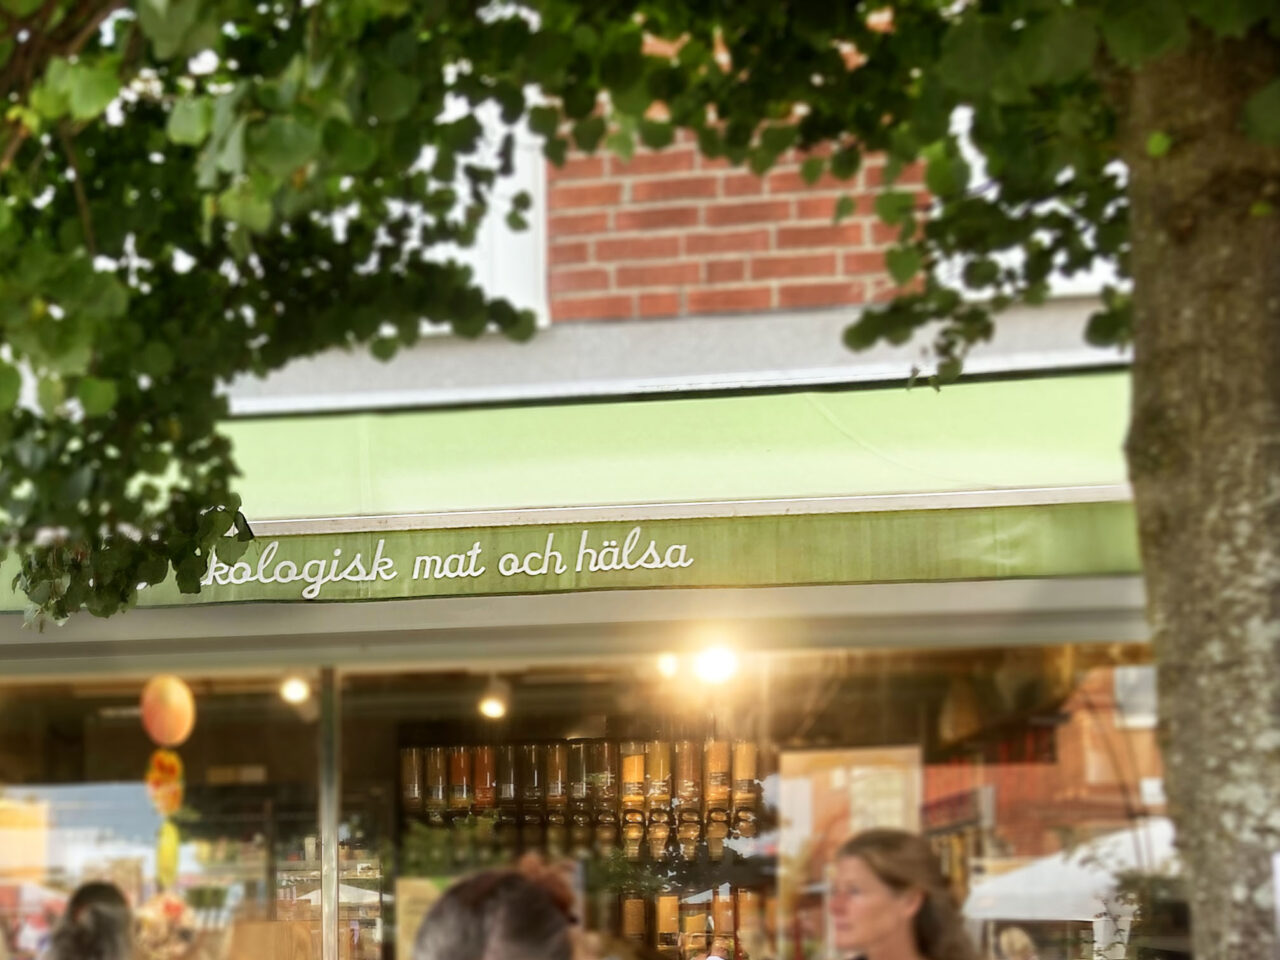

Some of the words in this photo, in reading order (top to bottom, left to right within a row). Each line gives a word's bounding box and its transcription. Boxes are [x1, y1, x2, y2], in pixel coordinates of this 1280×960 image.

[201, 539, 398, 600] kologisk
[412, 541, 486, 580] mat
[498, 532, 567, 577] och
[575, 526, 695, 573] hälsa
